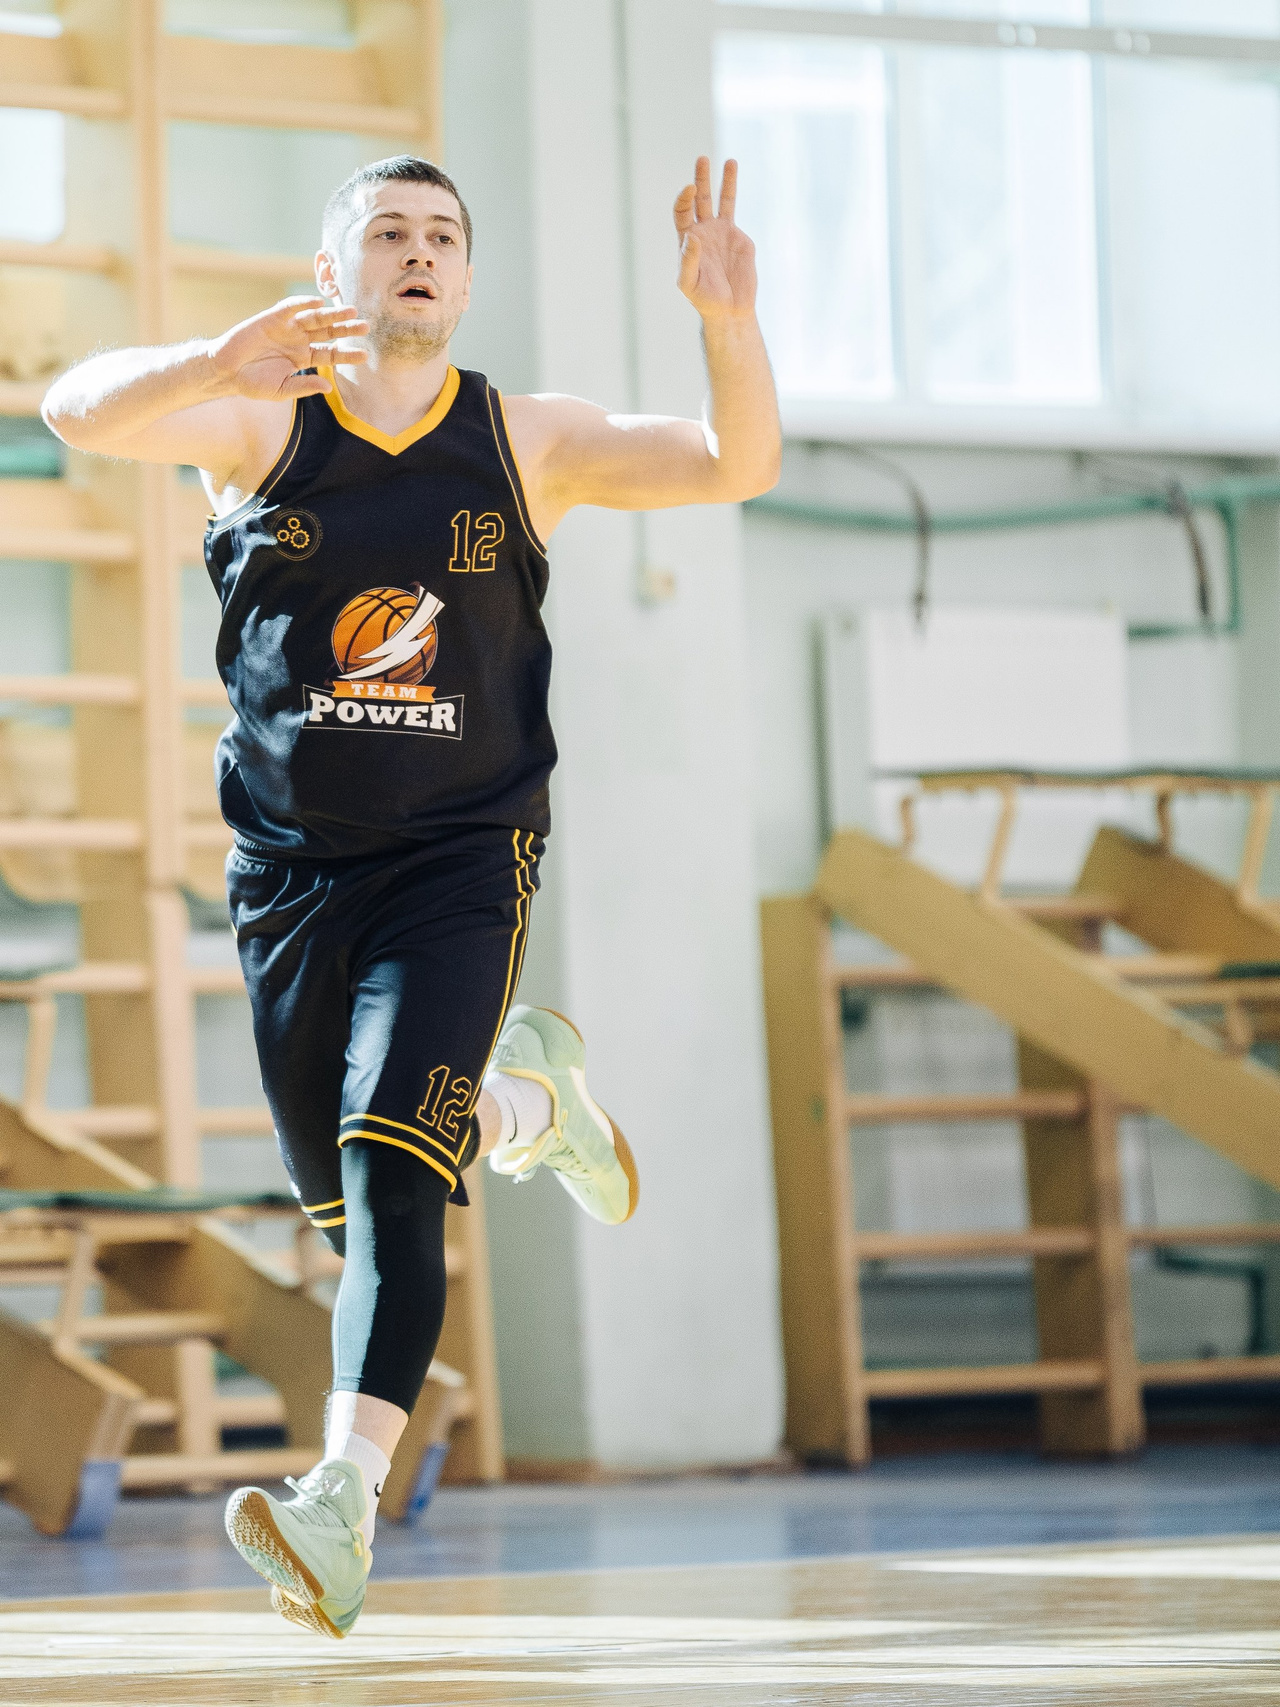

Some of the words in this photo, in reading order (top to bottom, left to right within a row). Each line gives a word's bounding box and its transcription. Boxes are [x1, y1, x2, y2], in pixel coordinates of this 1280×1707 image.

[449, 509, 505, 572] 12
[308, 692, 457, 732] POWER
[351, 683, 418, 699] TEAM
[417, 1065, 472, 1142] 12
